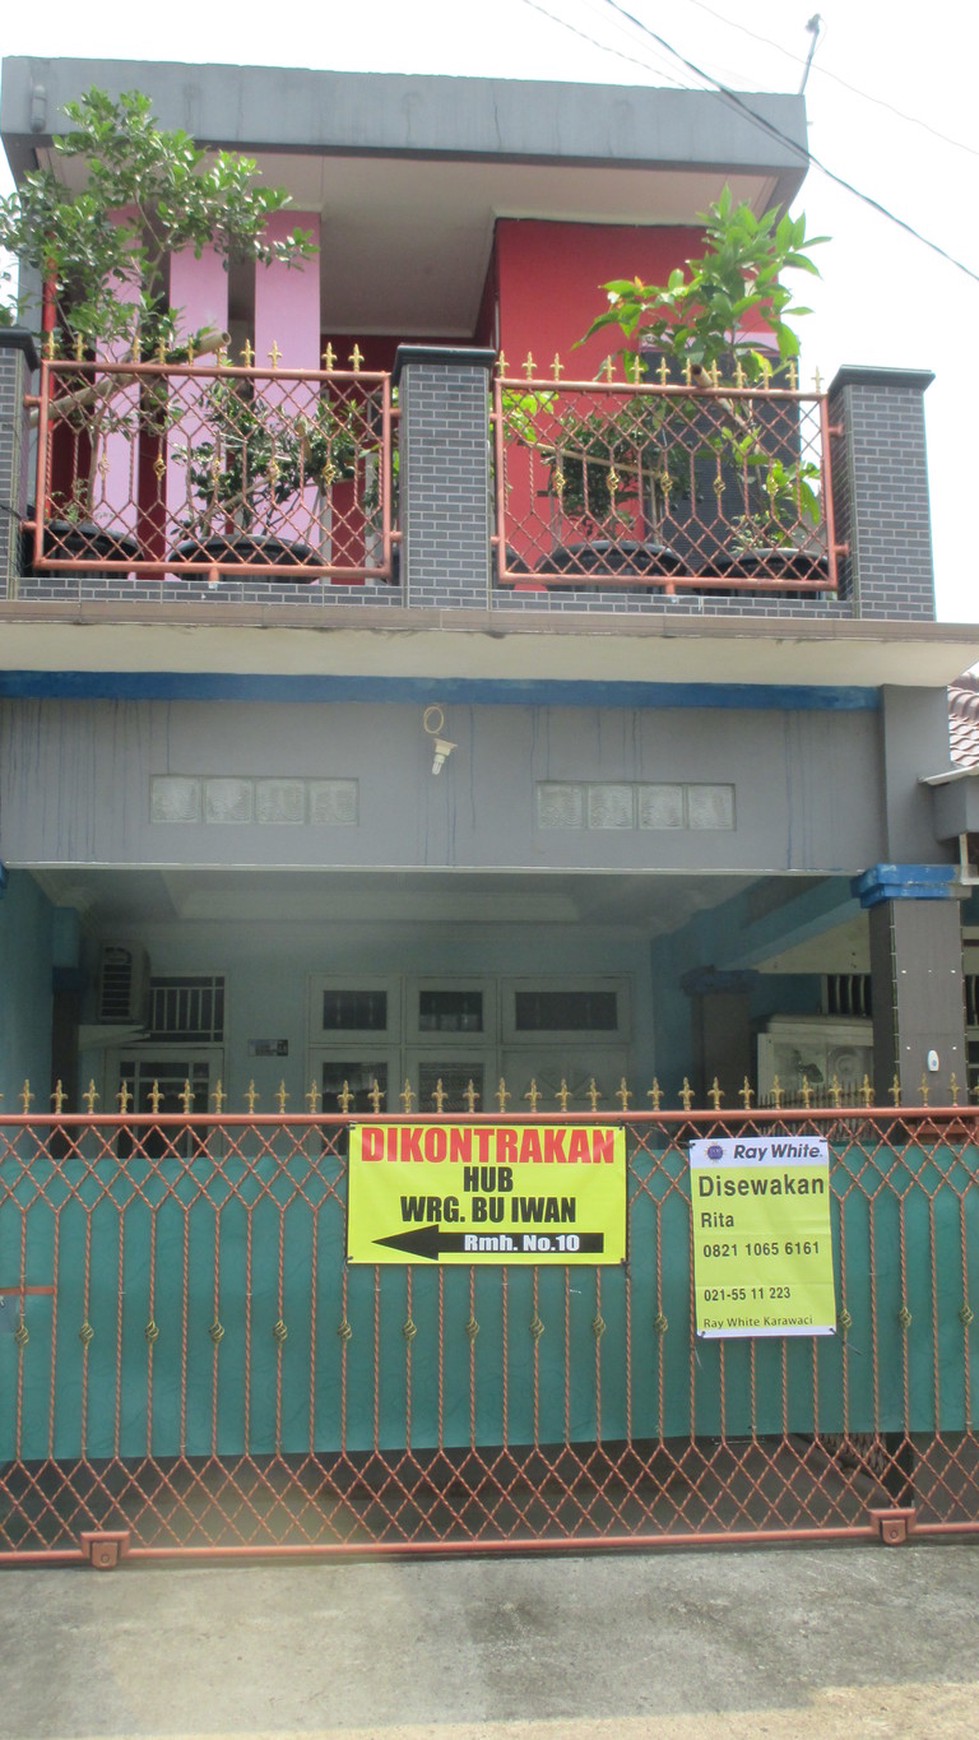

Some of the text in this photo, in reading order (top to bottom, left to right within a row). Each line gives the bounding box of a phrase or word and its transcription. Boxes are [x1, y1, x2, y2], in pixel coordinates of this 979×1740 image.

[361, 1127, 614, 1163] DIKONTRAKAN
[733, 1144, 767, 1161] Ray
[463, 1166, 513, 1192] HUB
[699, 1174, 824, 1197] Disewakan
[400, 1196, 576, 1223] WRG. BU IWAN
[701, 1212, 734, 1228] Rita
[464, 1234, 580, 1251] Rmh. No.10
[703, 1241, 819, 1258] 0821 1065 6161
[704, 1287, 791, 1301] 021-55 11 223
[703, 1315, 813, 1330] Ray White Karawaci
